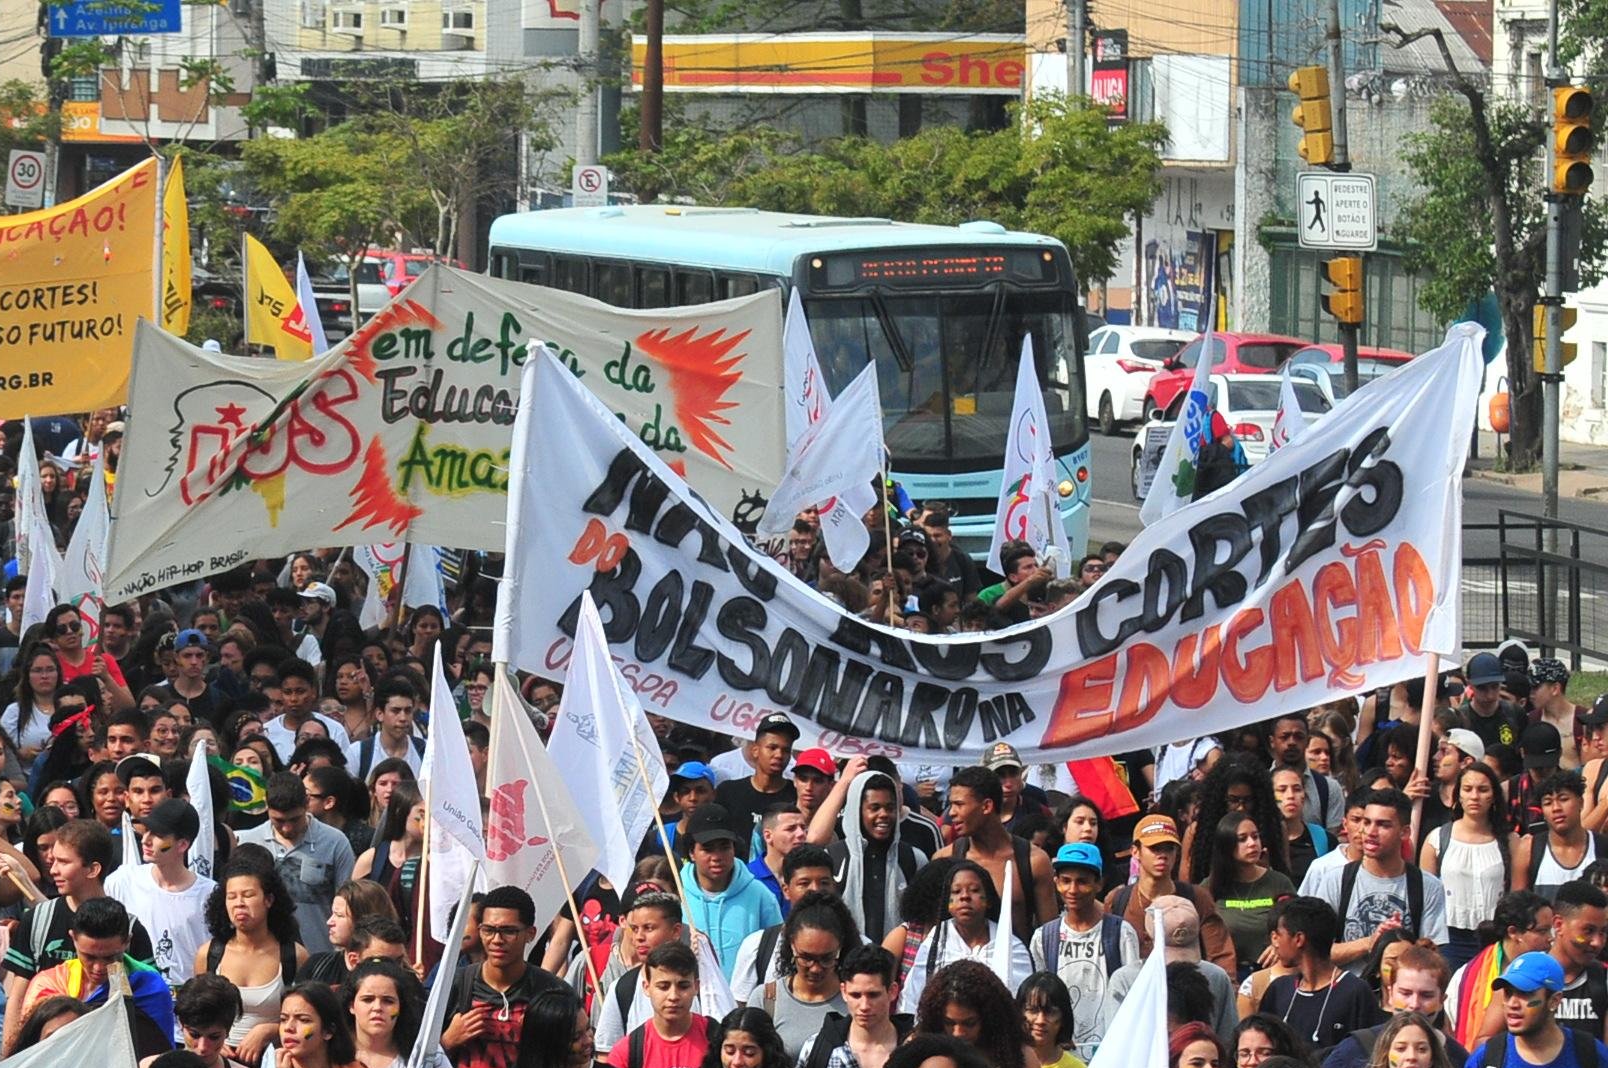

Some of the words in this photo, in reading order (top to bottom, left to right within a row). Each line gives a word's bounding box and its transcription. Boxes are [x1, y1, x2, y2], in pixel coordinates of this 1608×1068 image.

[921, 52, 1025, 86] She
[17, 163, 35, 177] 30
[0, 281, 97, 310] CORTES!
[28, 314, 122, 345] FUTURO!
[371, 327, 434, 361] em
[446, 311, 587, 378] defea
[604, 341, 655, 394] da
[375, 366, 520, 425] Educa
[568, 518, 630, 573] DO
[1076, 426, 1404, 660] CORTES
[556, 547, 979, 751] BOLSONARO
[978, 692, 1035, 743] NA
[1040, 538, 1434, 749] EDUCAÇÃO
